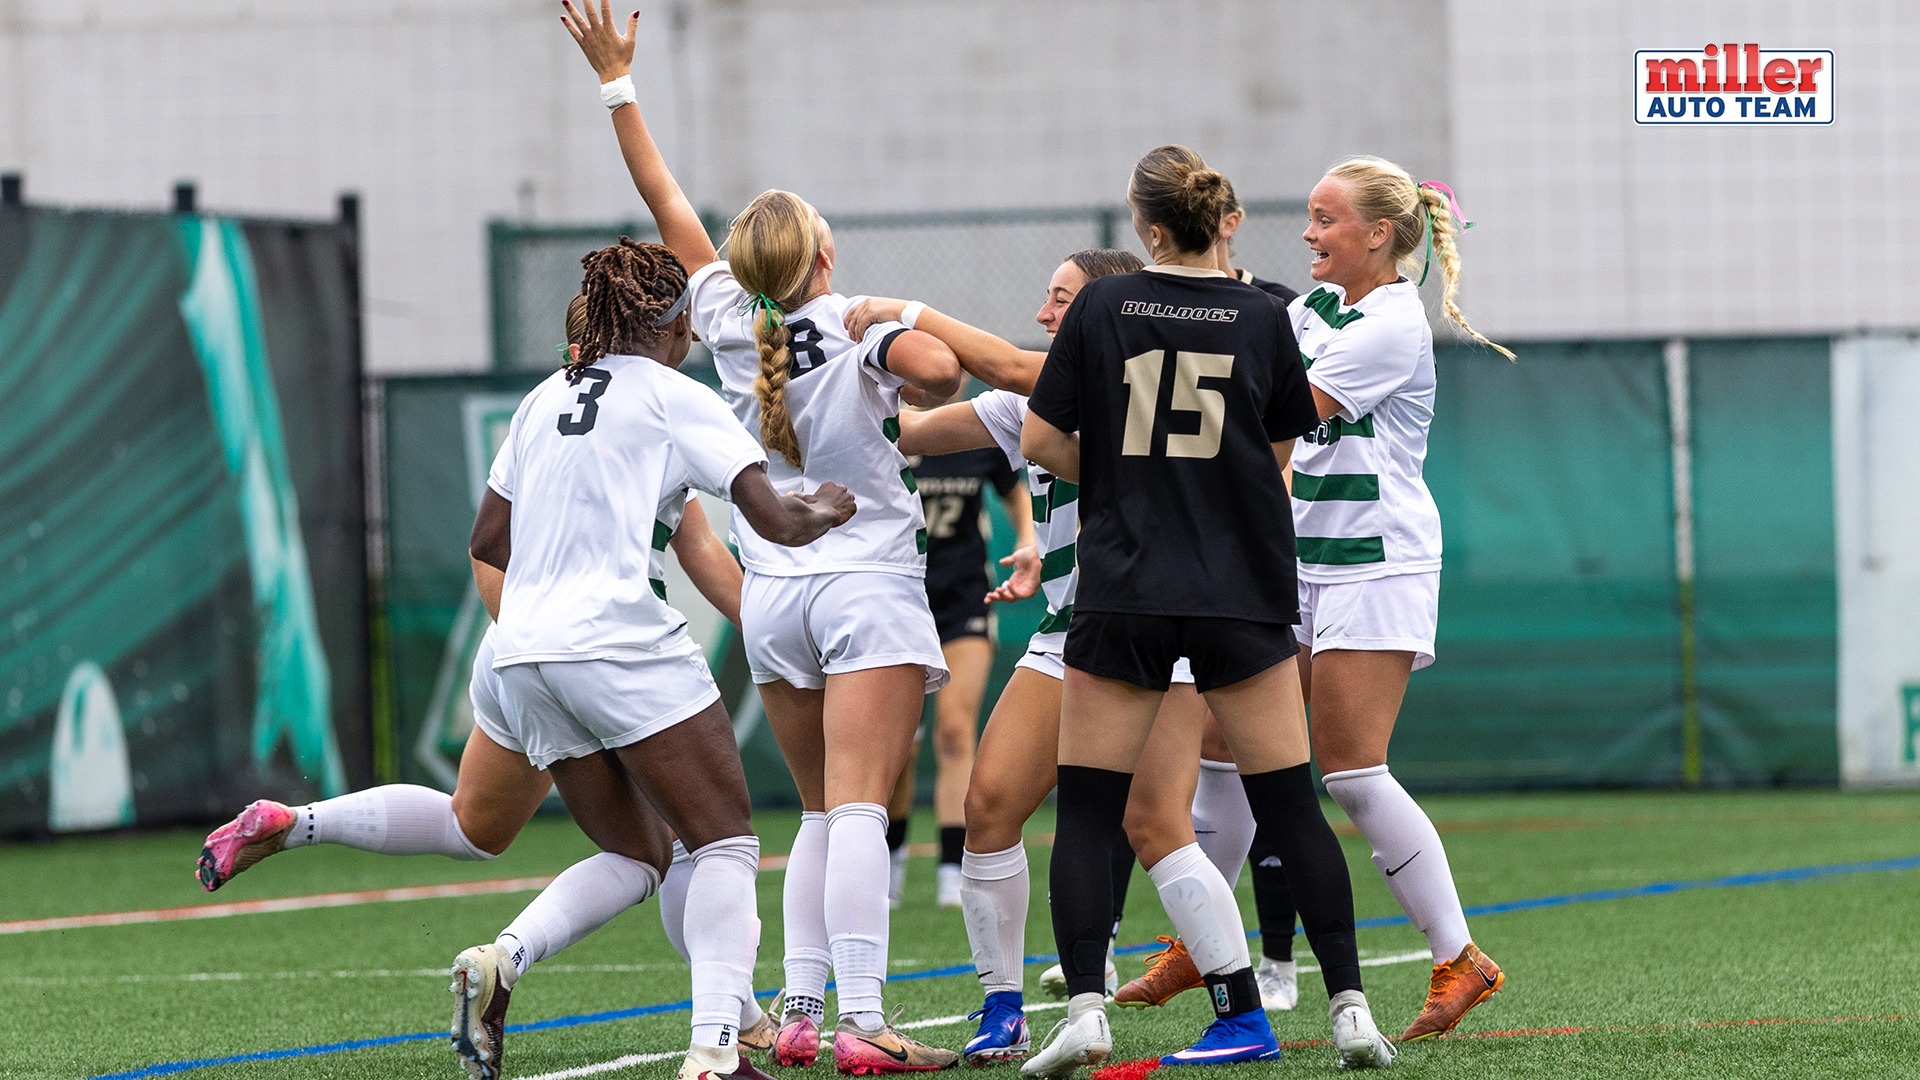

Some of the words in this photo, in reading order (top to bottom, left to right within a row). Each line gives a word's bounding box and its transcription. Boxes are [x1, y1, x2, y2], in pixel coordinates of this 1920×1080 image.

[1121, 301, 1239, 323] BULLDOGS
[556, 367, 613, 437] 3
[1121, 349, 1236, 460] 15
